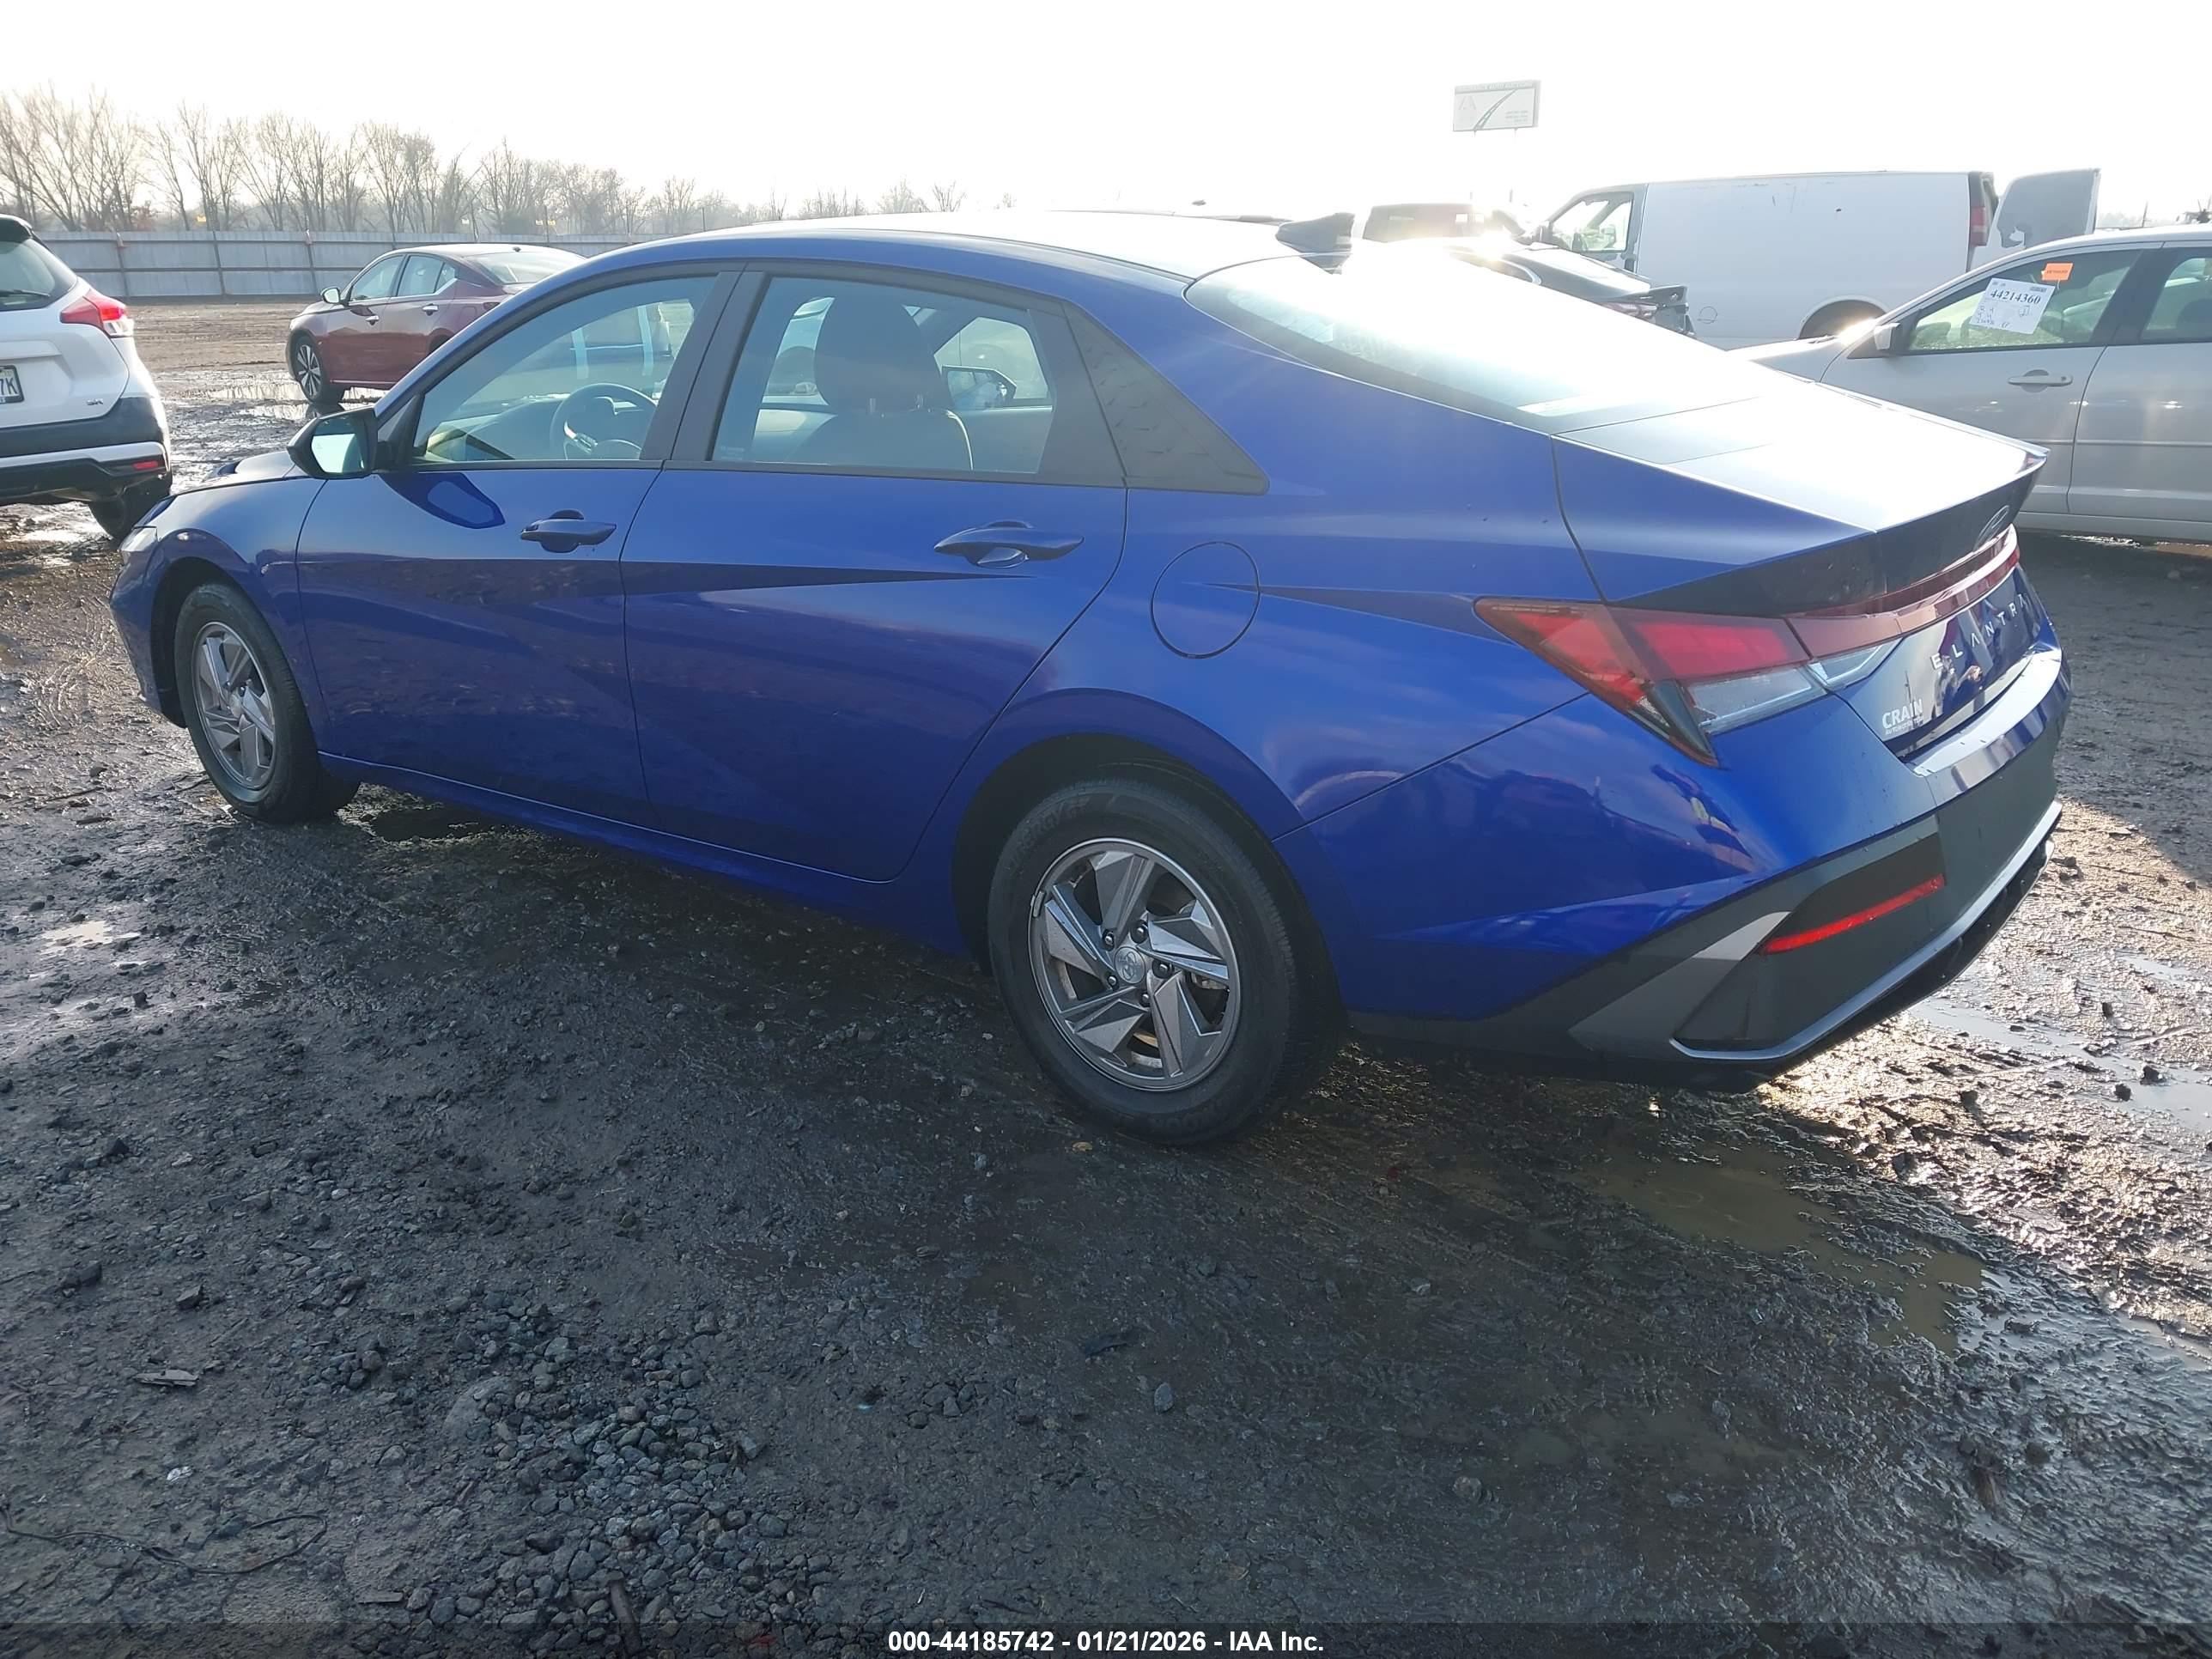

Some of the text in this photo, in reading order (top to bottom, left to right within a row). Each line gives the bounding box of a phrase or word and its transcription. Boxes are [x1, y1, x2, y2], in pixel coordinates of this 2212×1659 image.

[1990, 289, 2041, 304] 44214360
[1930, 593, 2029, 671] ELANTRA
[1881, 698, 1923, 729] CRAIN
